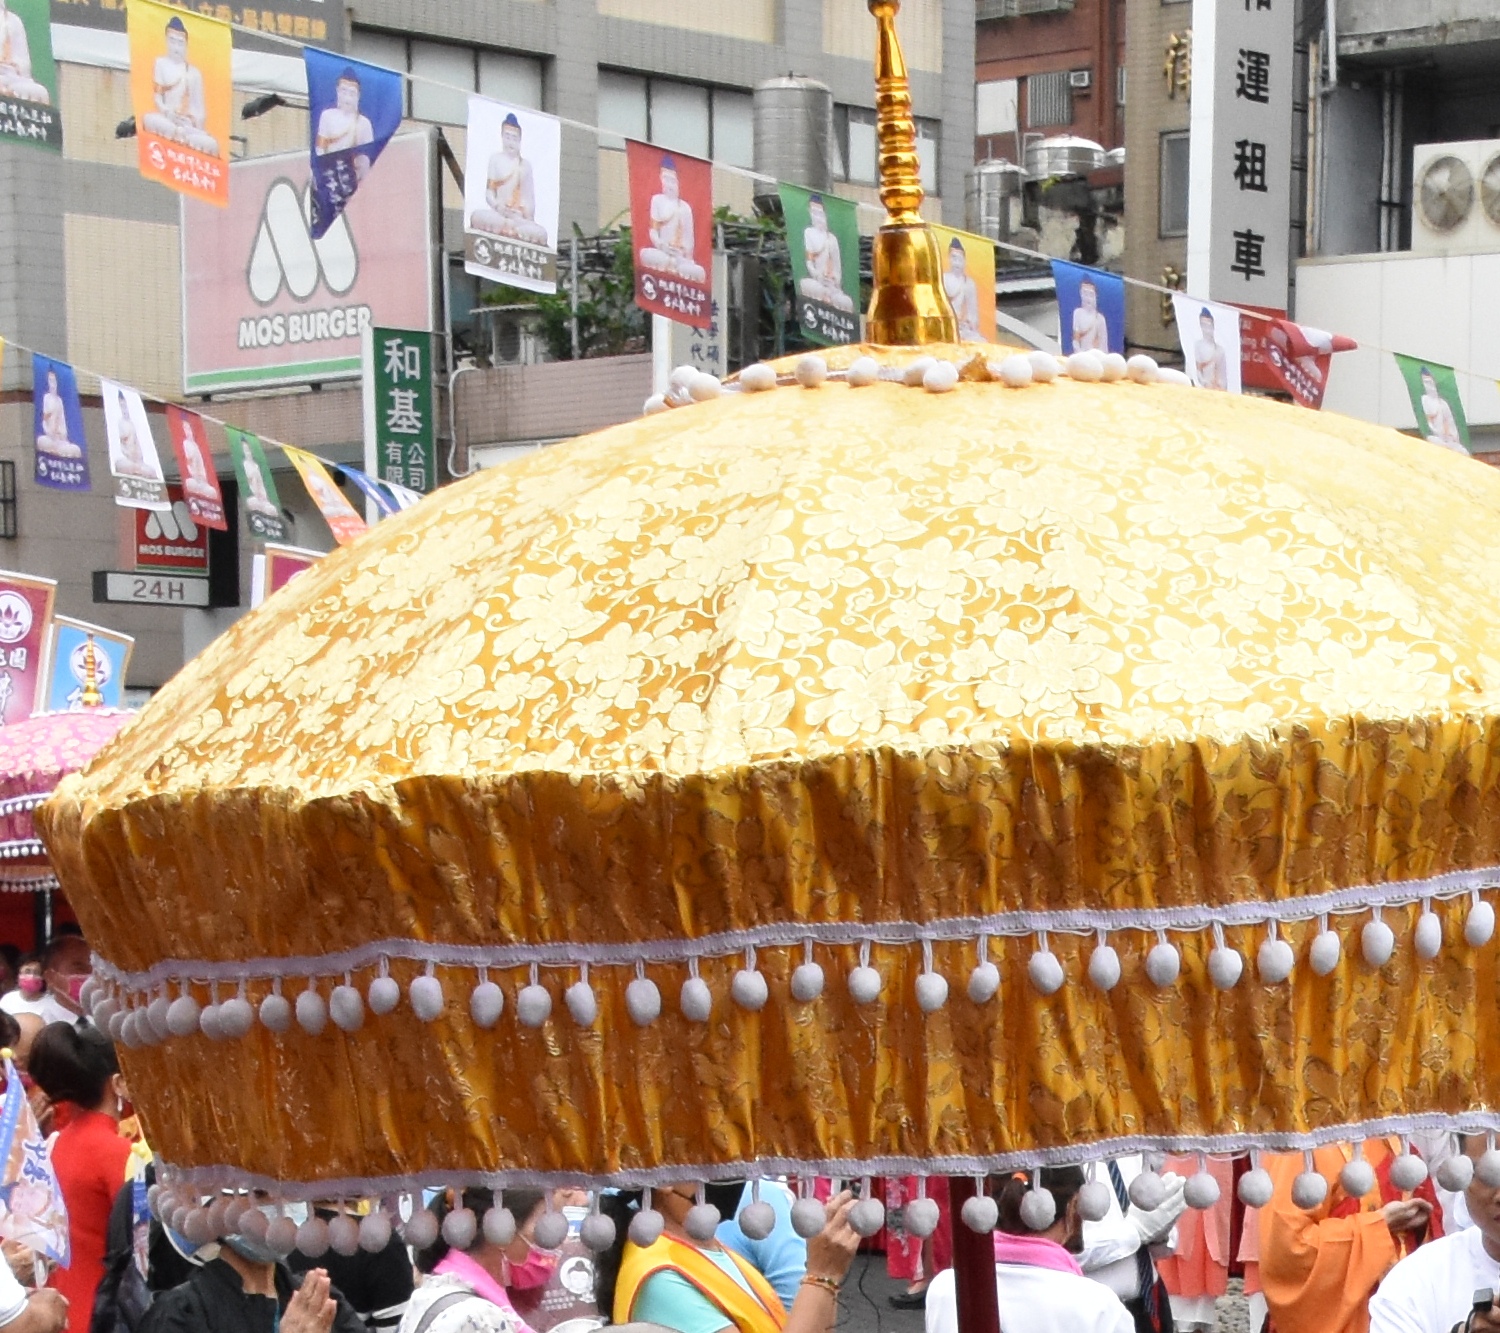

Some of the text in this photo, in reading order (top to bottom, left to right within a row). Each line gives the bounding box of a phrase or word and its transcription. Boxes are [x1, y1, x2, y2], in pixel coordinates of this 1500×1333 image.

[1230, 0, 1273, 282] 運租車
[238, 304, 372, 348] MOS BURGER
[383, 338, 423, 434] 和基
[408, 442, 426, 491] 公司
[138, 544, 163, 556] MOS
[133, 579, 184, 600] 24H
